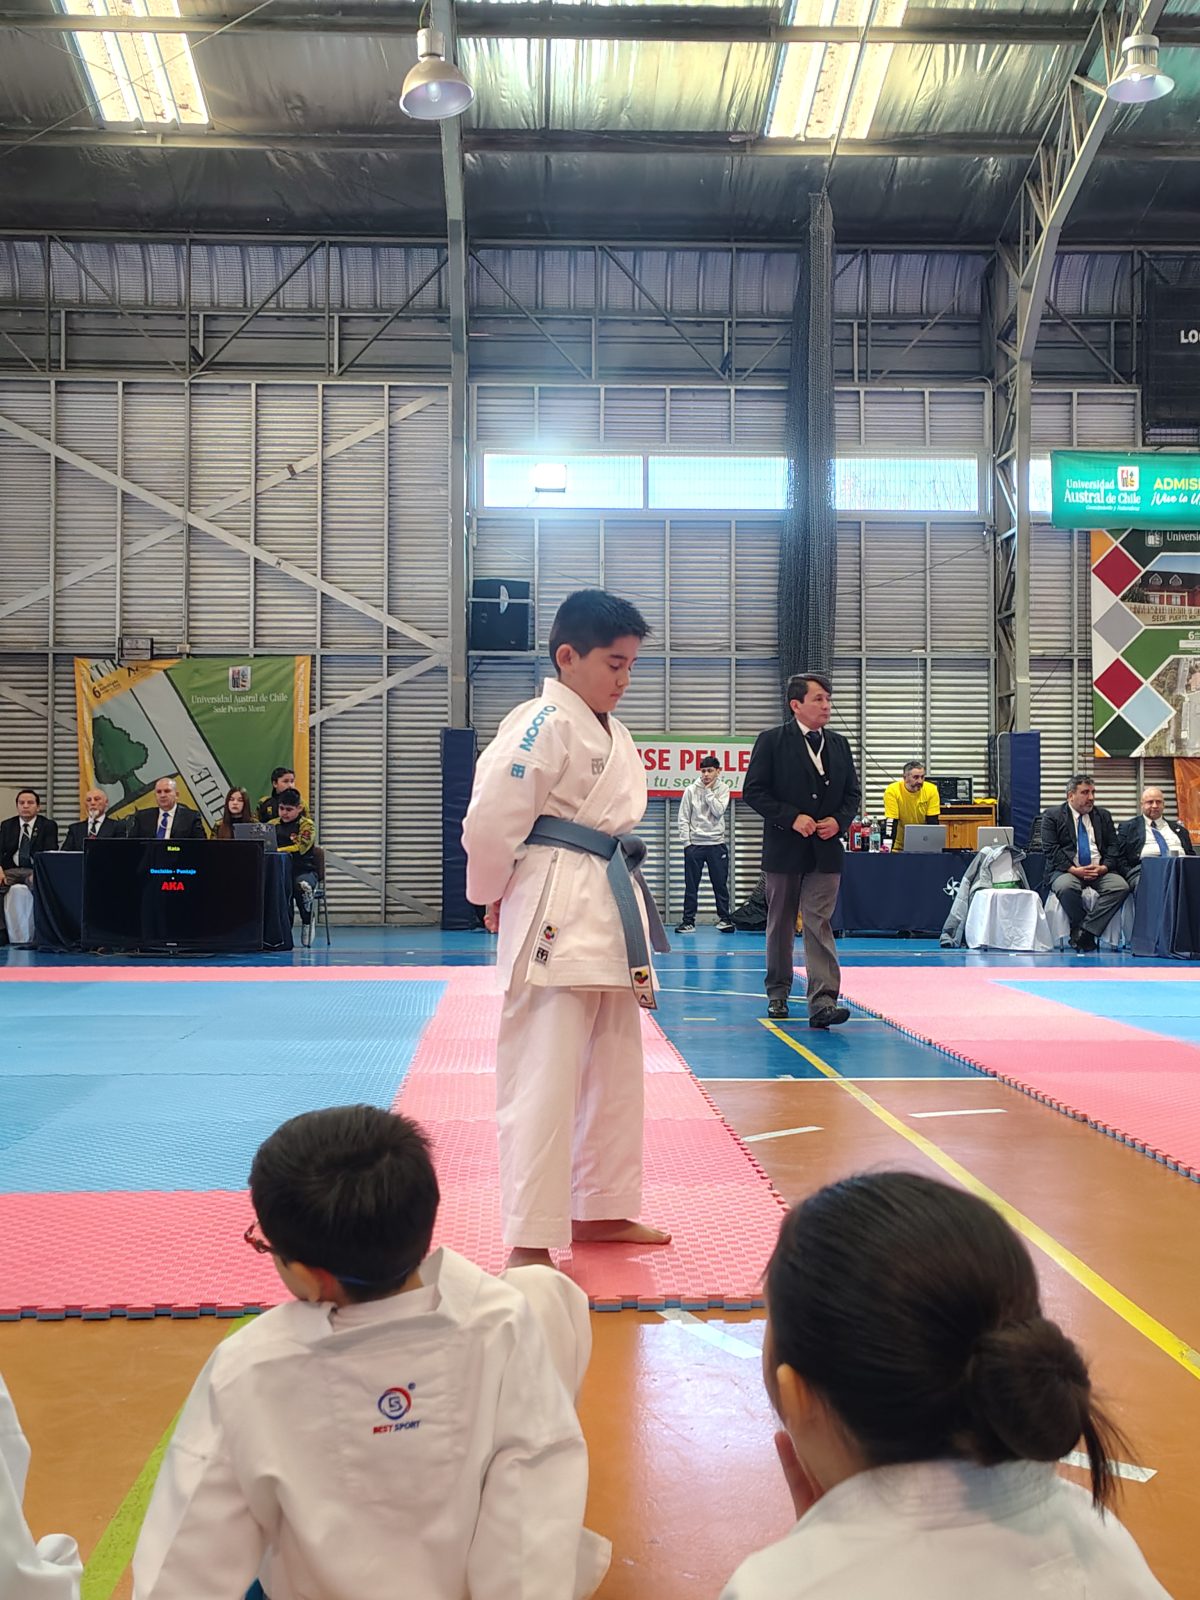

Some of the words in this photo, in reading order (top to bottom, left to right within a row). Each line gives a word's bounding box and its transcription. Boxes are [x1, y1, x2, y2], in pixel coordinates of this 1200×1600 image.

[1180, 329, 1200, 344] LO
[1066, 479, 1115, 490] Universidad
[1153, 477, 1200, 491] ADMIS
[1064, 489, 1104, 503] Austral
[1105, 492, 1116, 504] de
[1117, 492, 1141, 504] Chile
[1190, 492, 1200, 505] U
[1166, 531, 1200, 542] Universi
[1151, 614, 1167, 622] SEDE
[1188, 631, 1195, 640] 6
[92, 686, 101, 699] 6
[191, 695, 232, 704] Universidad
[233, 694, 258, 703] Austral
[259, 694, 268, 702] de
[269, 692, 288, 702] Chile
[212, 705, 227, 713] Sede
[228, 704, 247, 713] Puerto
[519, 705, 557, 752] MOOTO
[638, 748, 671, 770] SE
[654, 775, 668, 787] tu
[162, 882, 184, 891] AKA
[373, 1425, 393, 1434] BEST
[394, 1420, 421, 1431] SPORT
